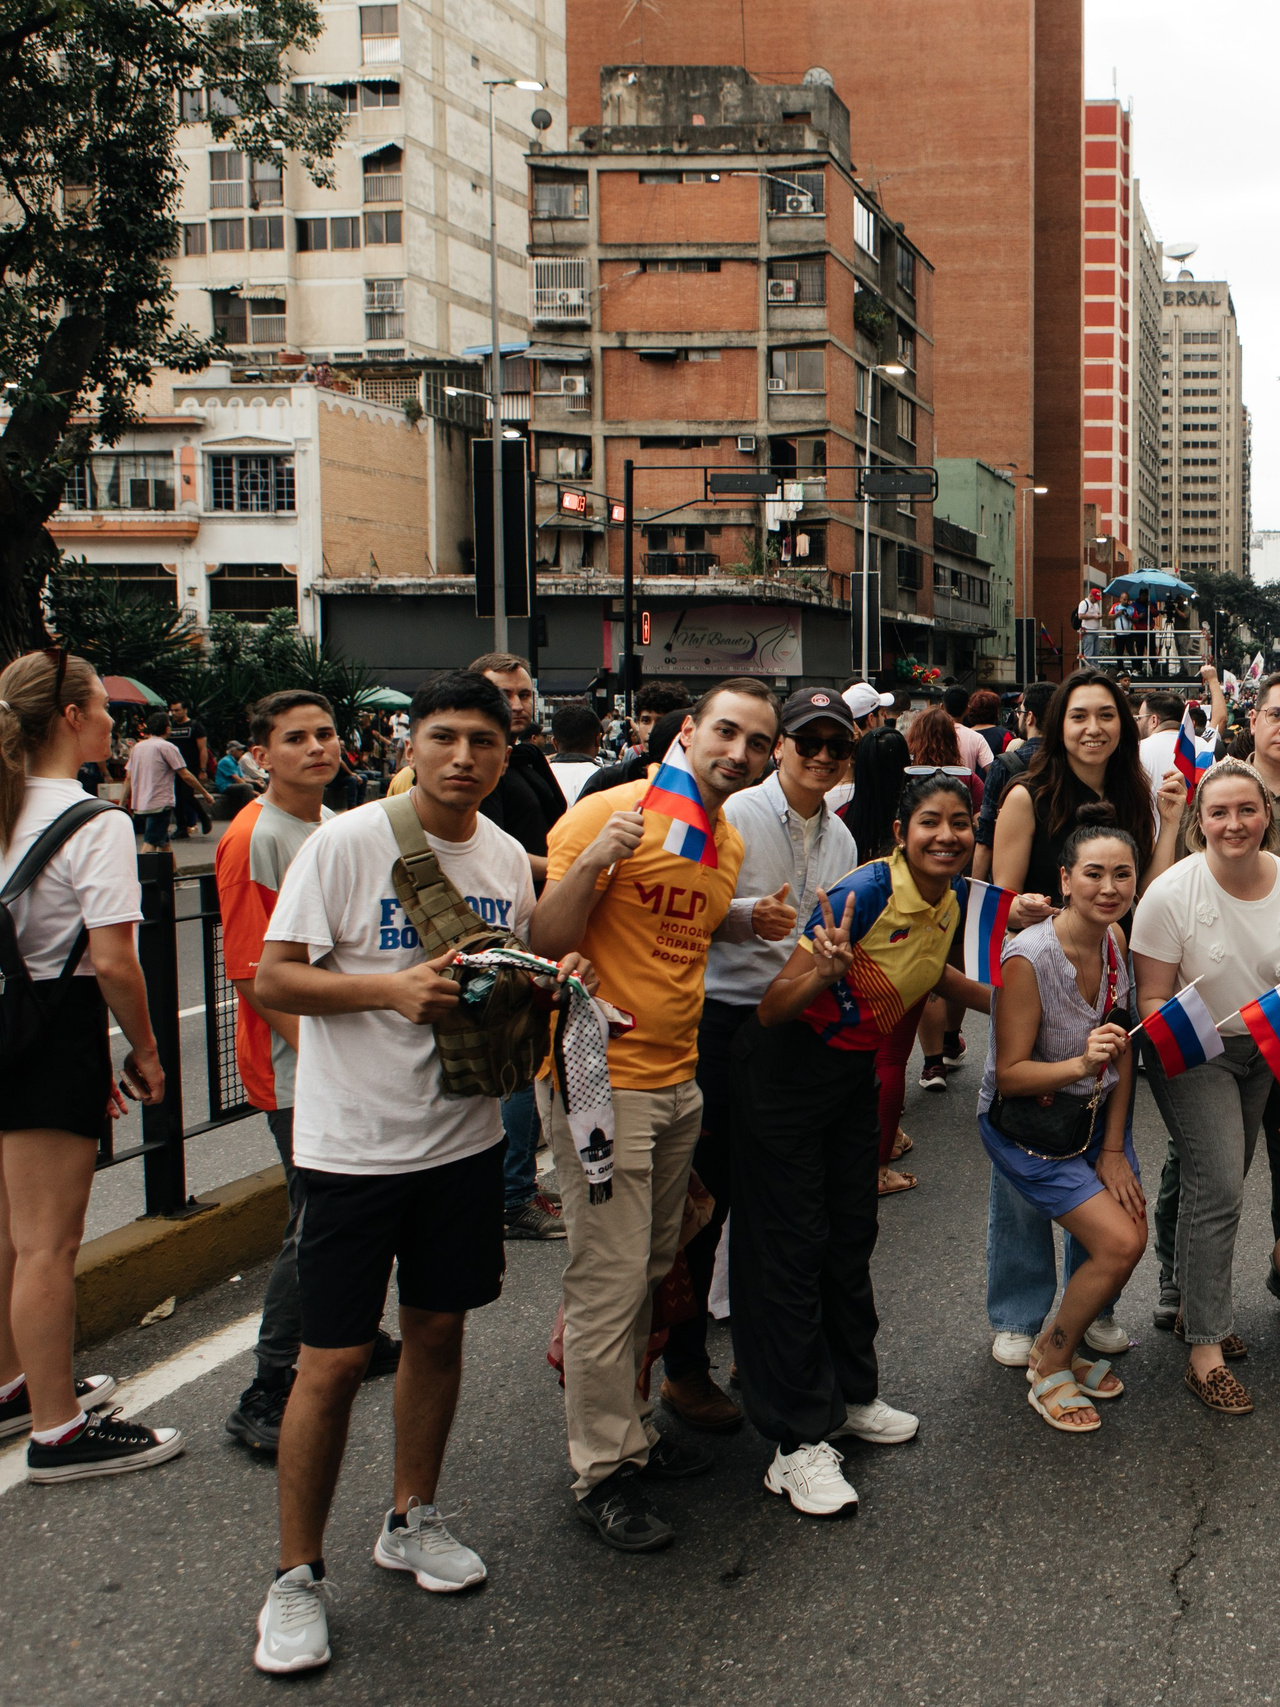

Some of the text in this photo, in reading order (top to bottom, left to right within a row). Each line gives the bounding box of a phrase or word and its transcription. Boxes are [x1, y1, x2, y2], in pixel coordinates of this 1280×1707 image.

[1162, 290, 1221, 307] ERSAL
[707, 631, 751, 648] Beauty
[598, 1161, 614, 1174] QUD
